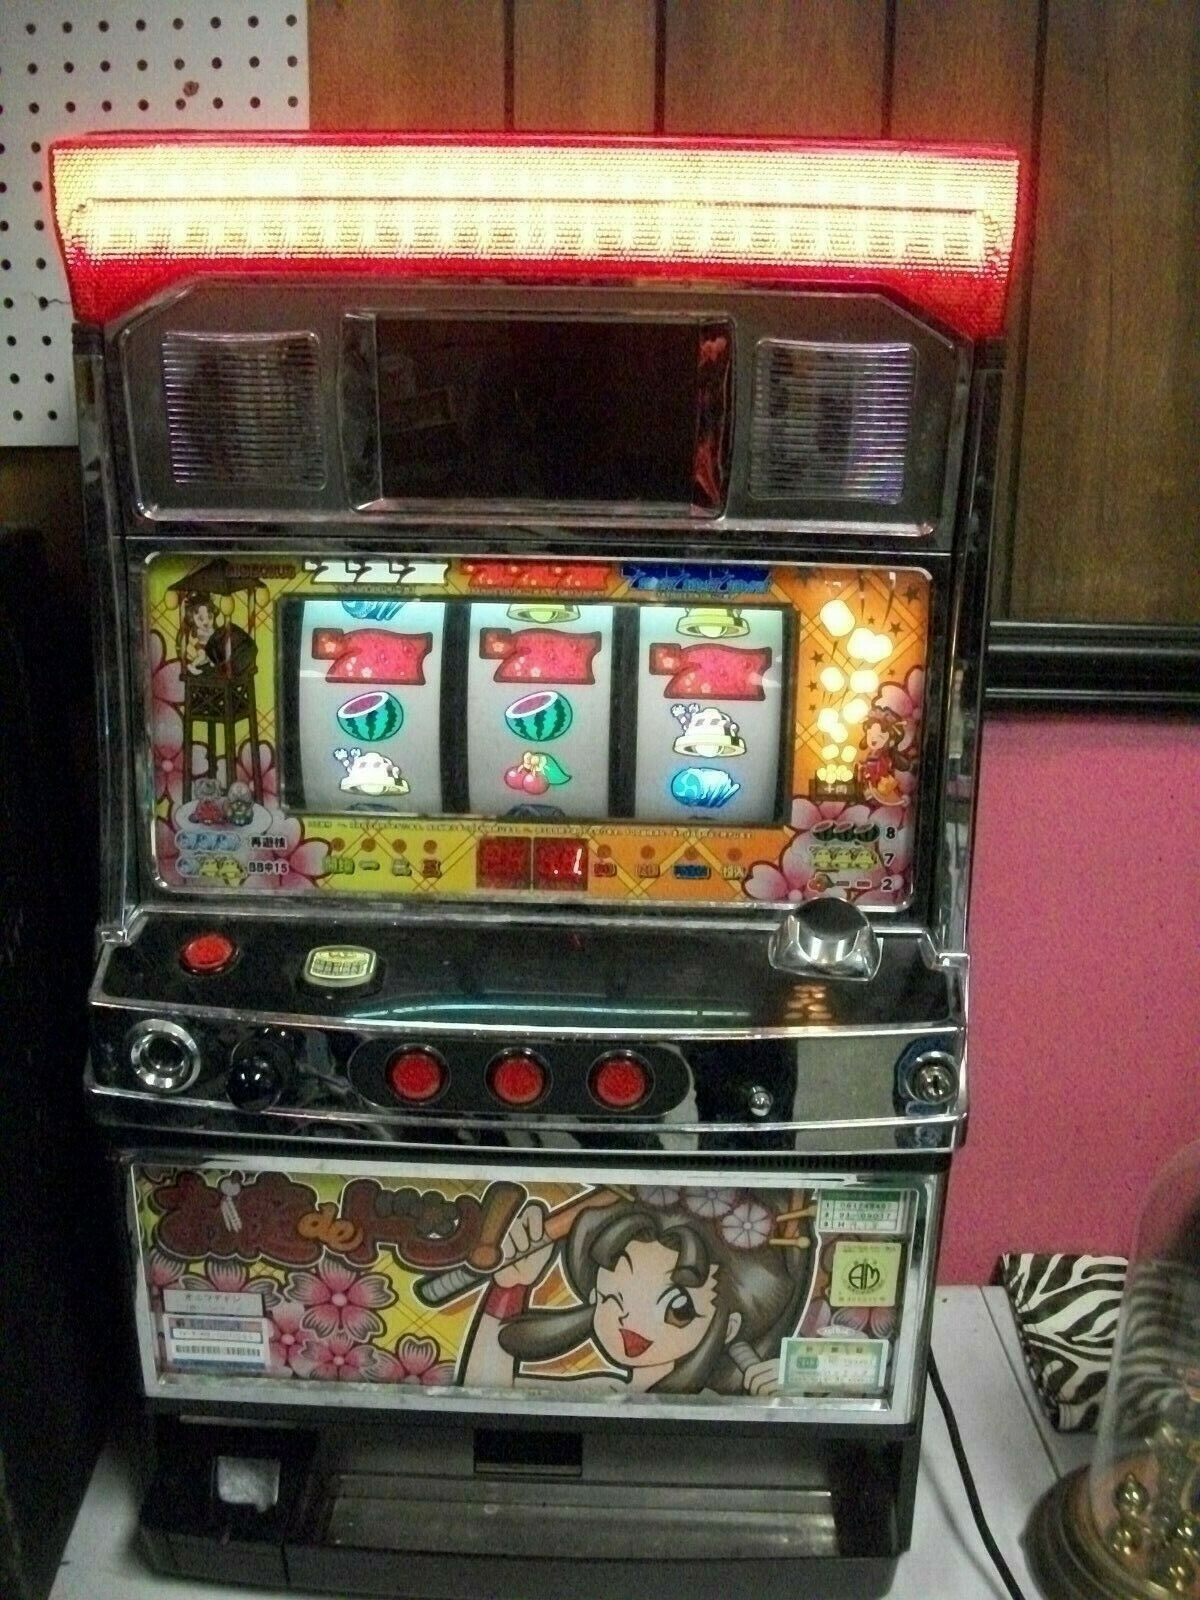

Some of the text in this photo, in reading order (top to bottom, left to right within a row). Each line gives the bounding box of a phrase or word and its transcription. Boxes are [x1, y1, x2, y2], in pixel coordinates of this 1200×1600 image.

[885, 826, 896, 840] 8
[884, 853, 895, 867] 7
[882, 878, 893, 891] 2
